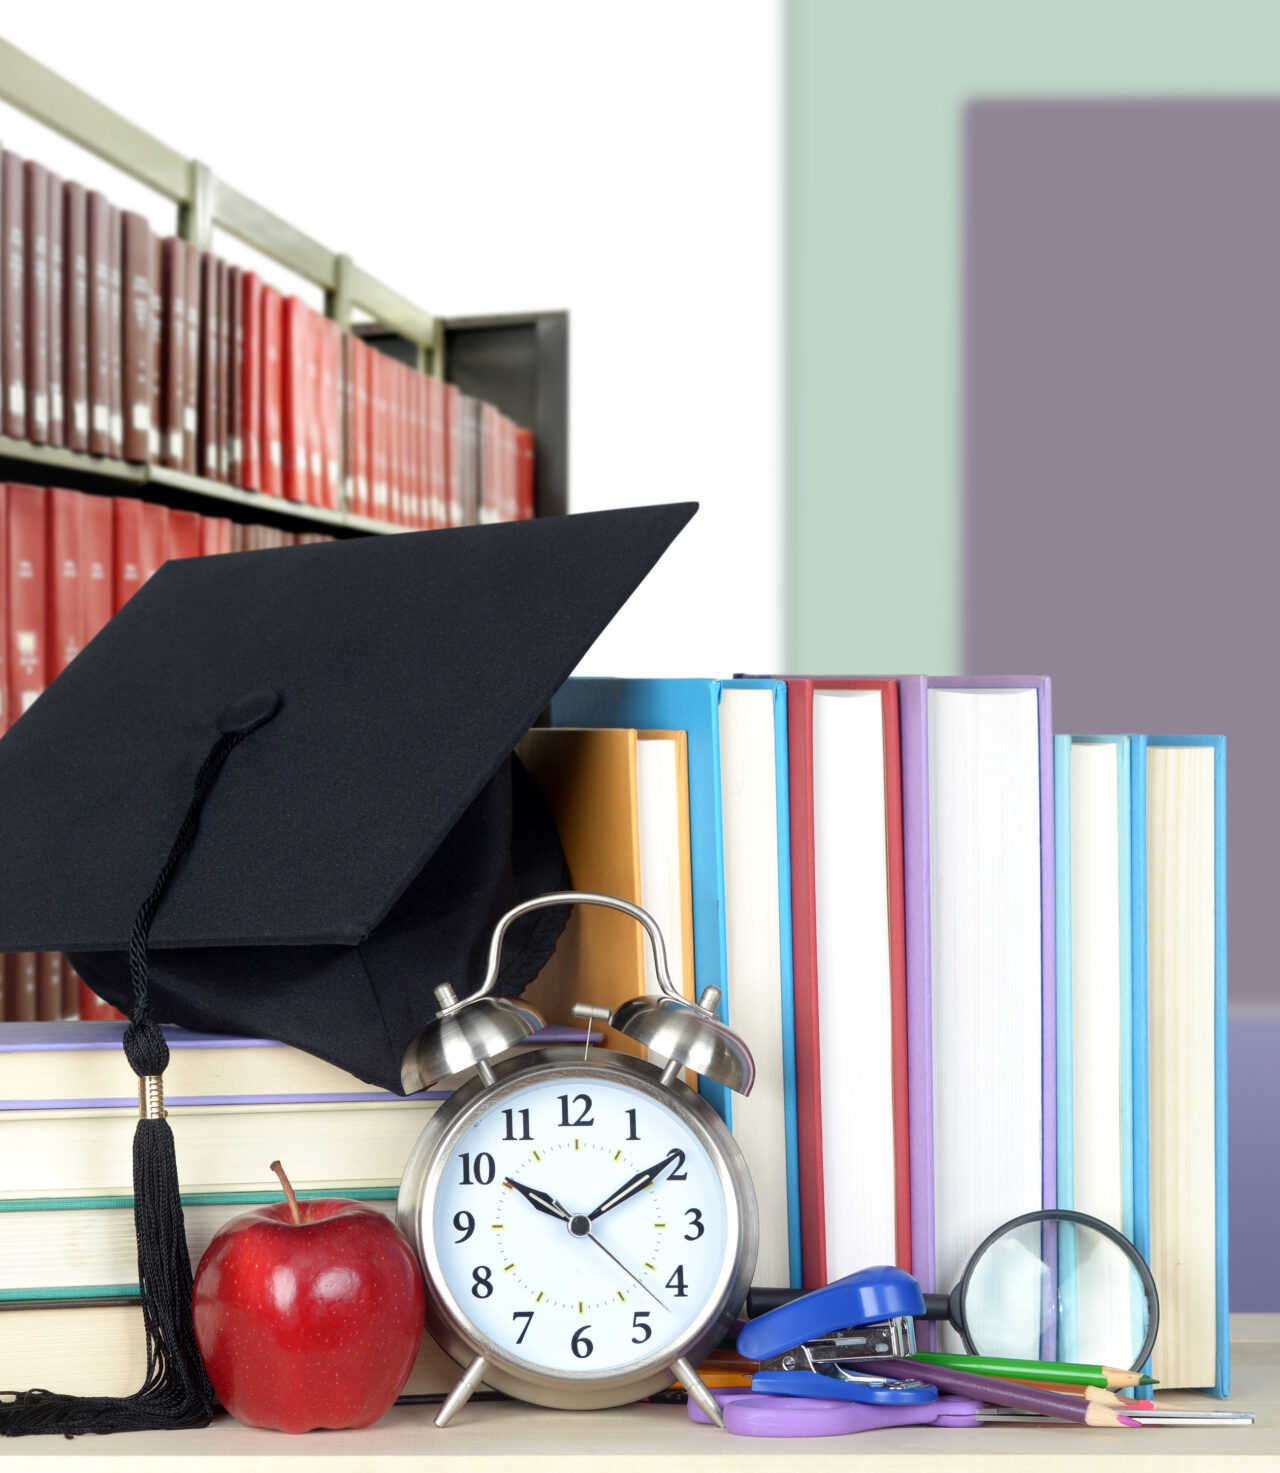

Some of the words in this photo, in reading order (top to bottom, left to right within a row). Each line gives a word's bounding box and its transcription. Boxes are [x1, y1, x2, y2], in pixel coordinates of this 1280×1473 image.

[502, 1108, 534, 1141] 11
[557, 1094, 594, 1127] 12
[625, 1108, 641, 1141] 1
[459, 1152, 496, 1185] 10
[666, 1148, 688, 1181] 2
[453, 1211, 475, 1244] 9
[684, 1208, 705, 1241] 3
[471, 1265, 494, 1299] 8
[665, 1265, 688, 1297] 4
[512, 1311, 535, 1344] 7
[571, 1325, 594, 1358] 6
[631, 1311, 652, 1344] 5
